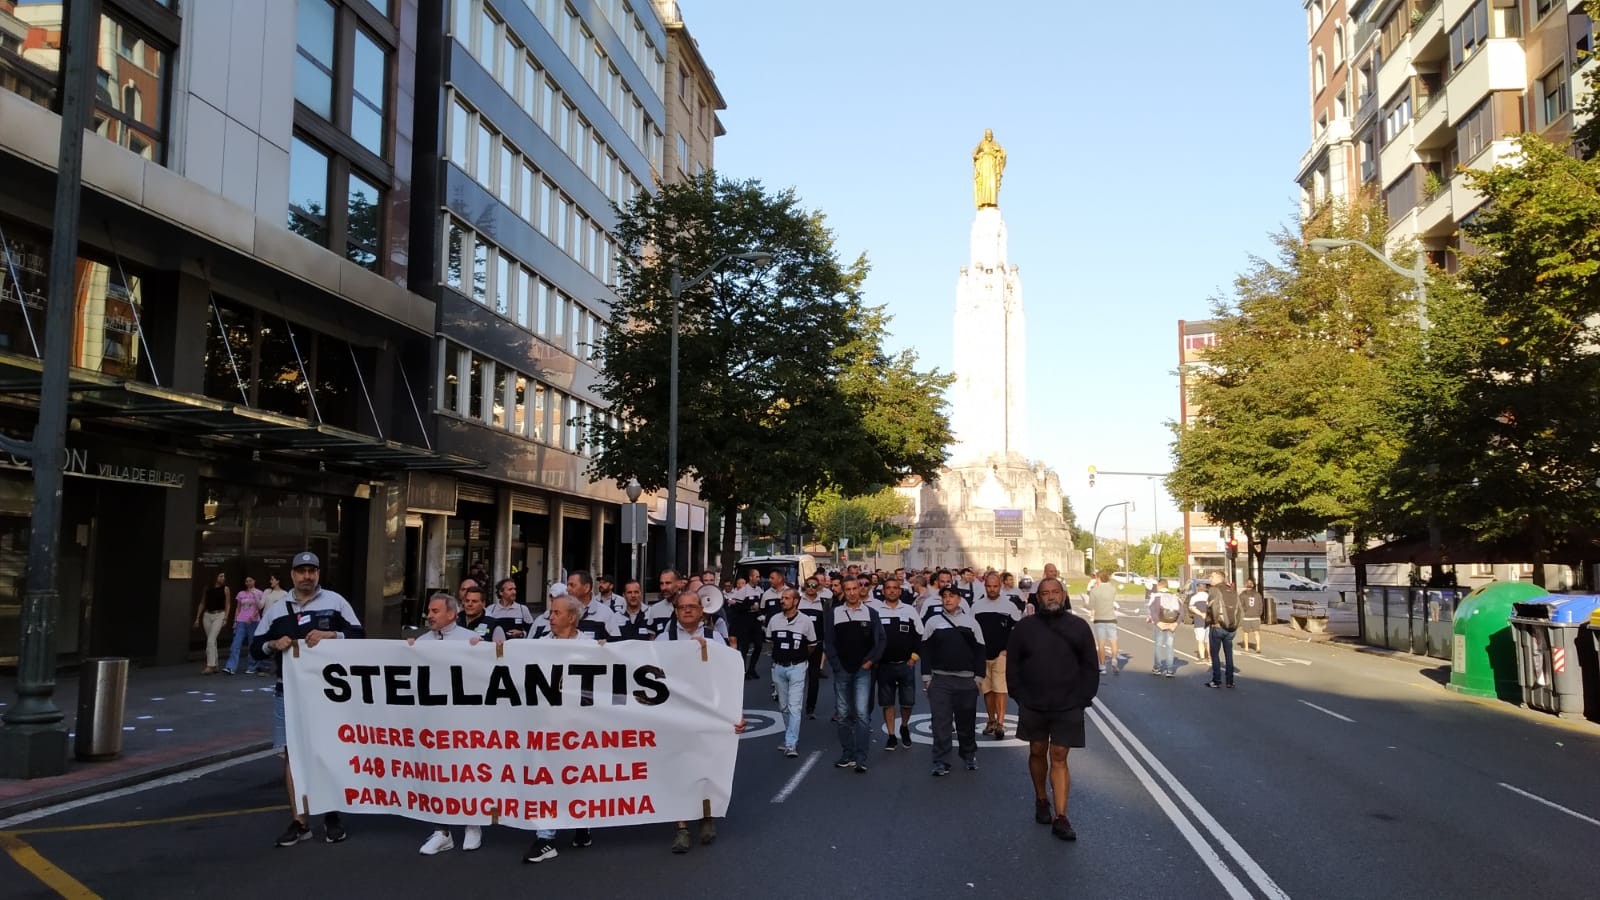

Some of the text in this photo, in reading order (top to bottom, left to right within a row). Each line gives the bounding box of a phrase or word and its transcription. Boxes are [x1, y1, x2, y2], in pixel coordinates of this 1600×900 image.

[99, 463, 130, 479] VILLA
[132, 468, 147, 481] DE
[322, 663, 670, 707] STELLANTIS
[338, 724, 656, 751] QUIERE CERRAR MECANER
[349, 755, 648, 785] 148 FAMILIAS A LA CALLE
[345, 787, 656, 820] PARA PRODUCIR EN CHINA
